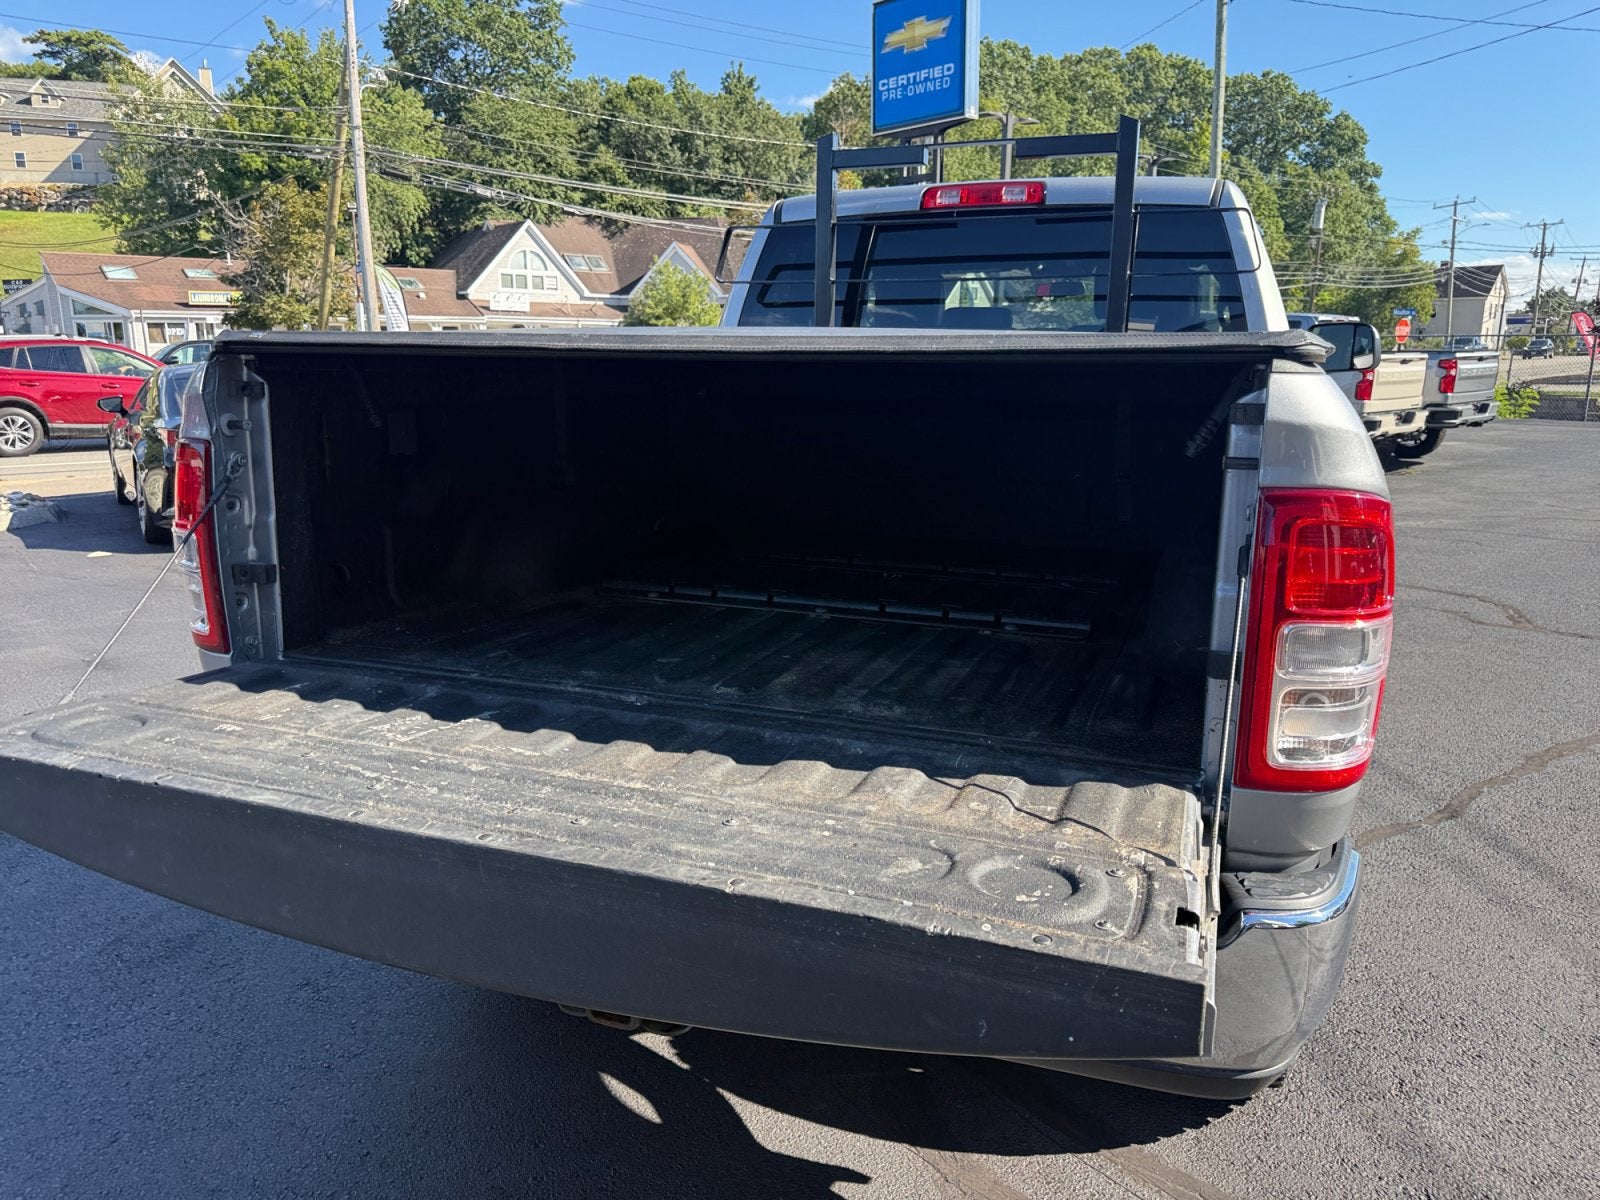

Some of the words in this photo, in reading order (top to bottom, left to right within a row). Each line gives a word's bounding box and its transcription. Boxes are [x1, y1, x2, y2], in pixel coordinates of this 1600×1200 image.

[878, 63, 954, 91] CERTIFIED
[882, 77, 951, 102] PRE-OWNED
[168, 328, 184, 336] OPEN
[1395, 325, 1410, 336] STOP
